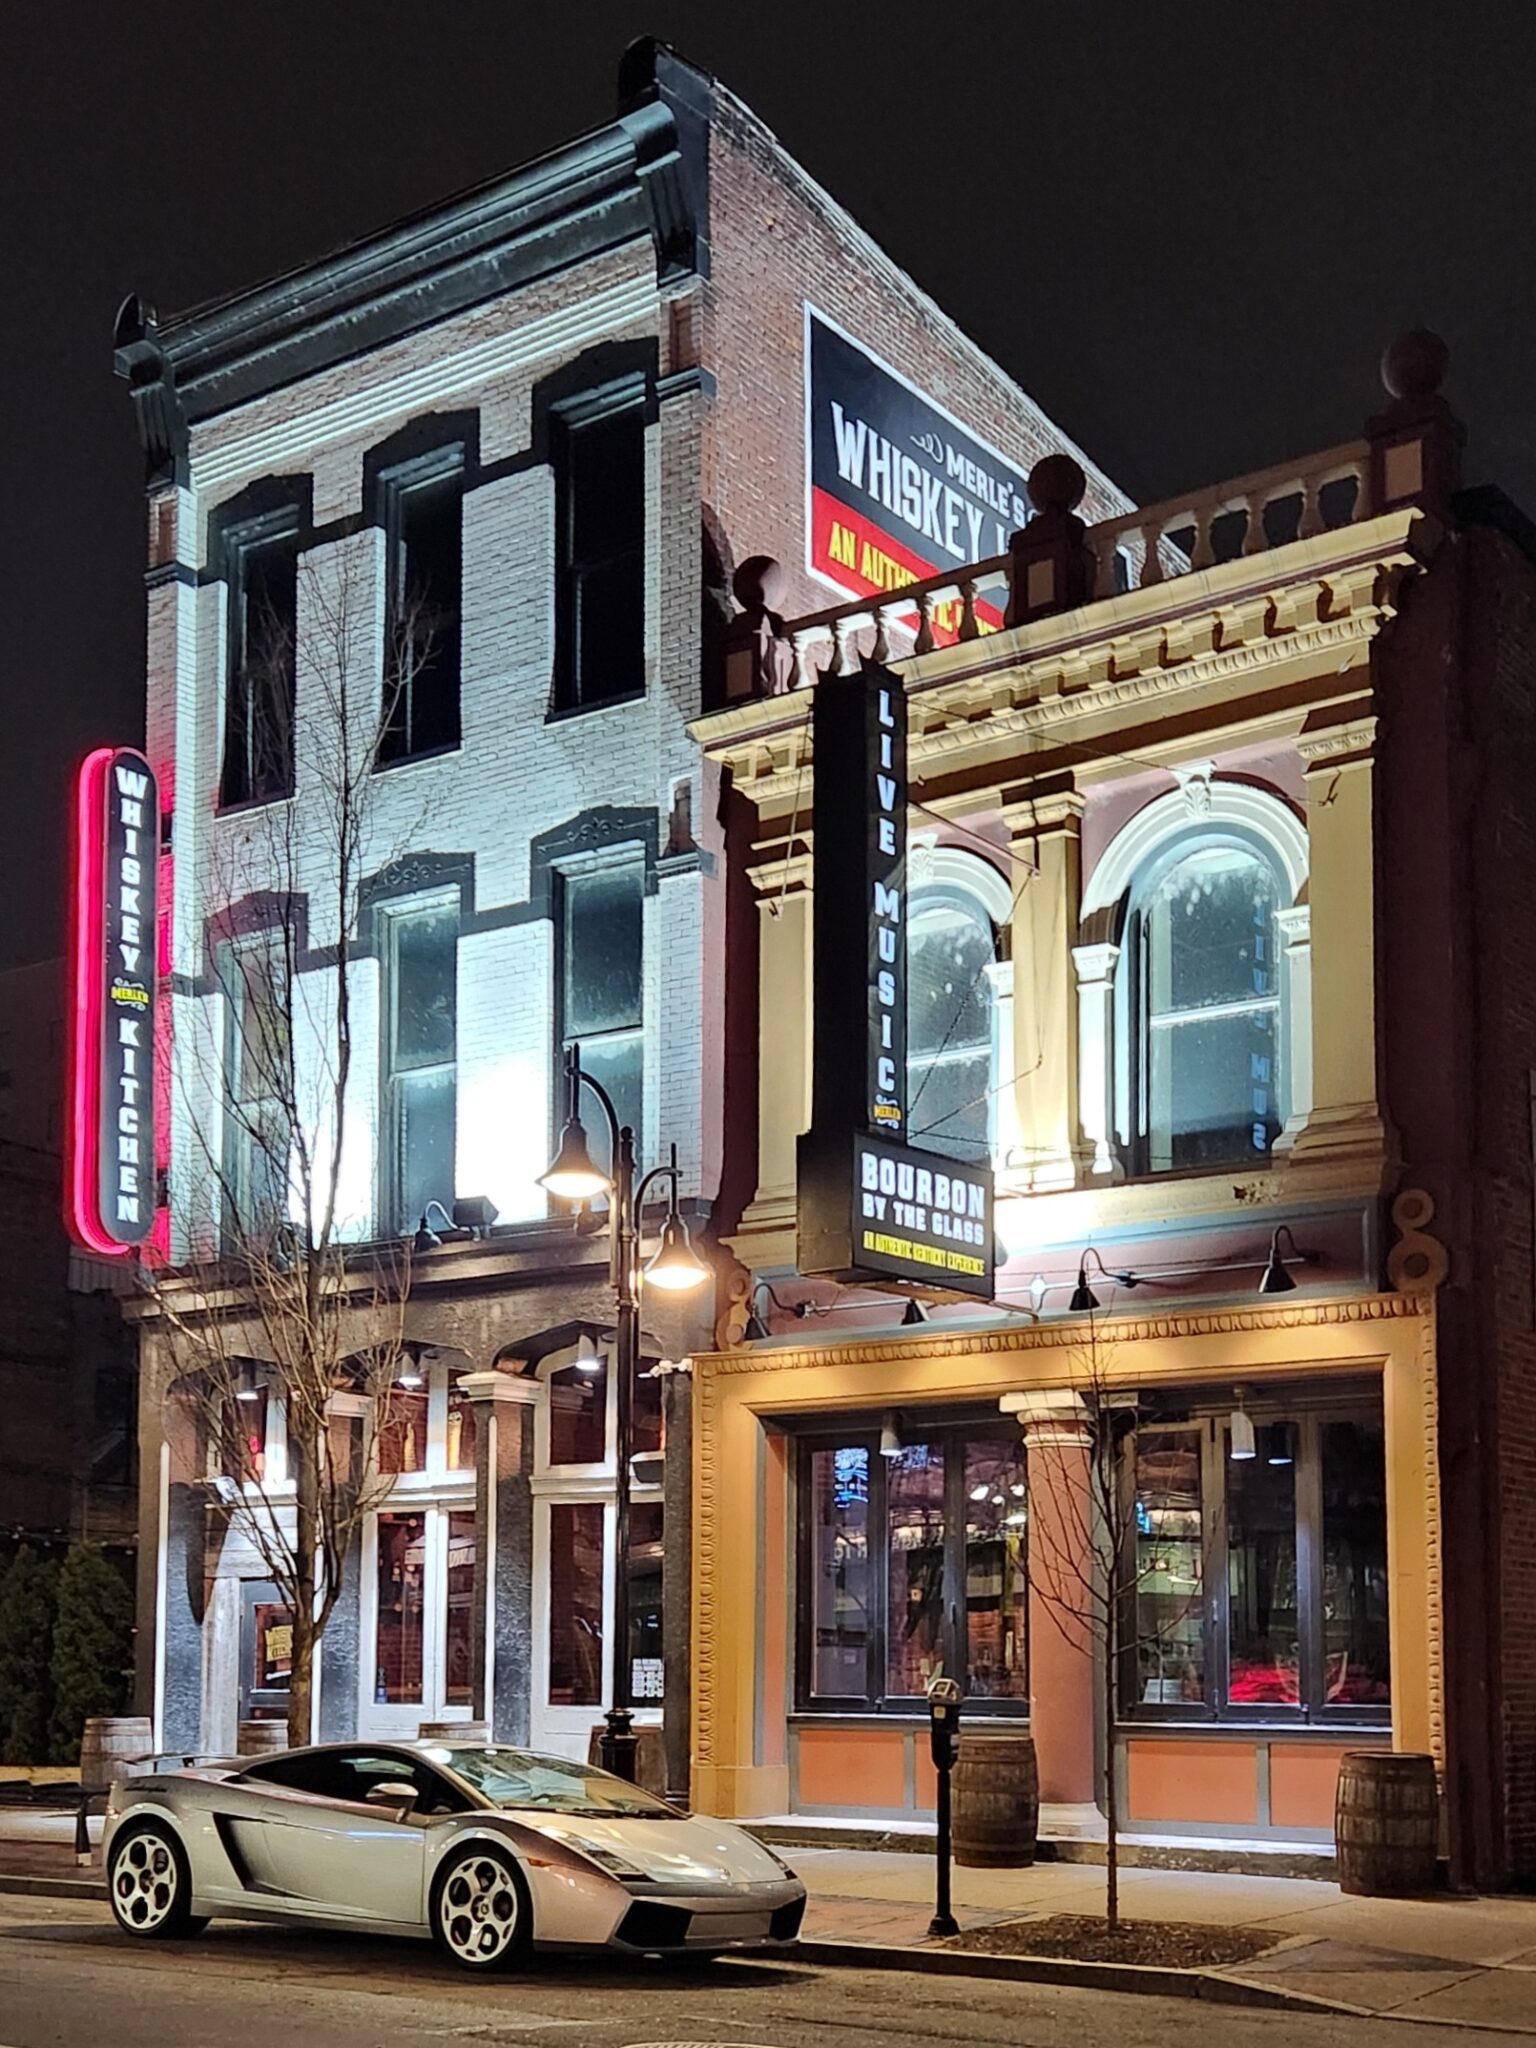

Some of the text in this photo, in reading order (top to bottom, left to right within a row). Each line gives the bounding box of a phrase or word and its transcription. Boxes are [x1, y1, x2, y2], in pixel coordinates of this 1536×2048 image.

[828, 520, 857, 571] AN
[830, 400, 985, 565] WHISKEY
[945, 443, 1026, 530] MERLE'S
[876, 688, 897, 856] LIVE
[115, 765, 149, 972] WHISKEY
[873, 880, 900, 1092] MUSIC
[116, 1017, 140, 1224] KITCHEN
[861, 1151, 986, 1220] BOURBON
[862, 1192, 985, 1246] BY THE GLASS
